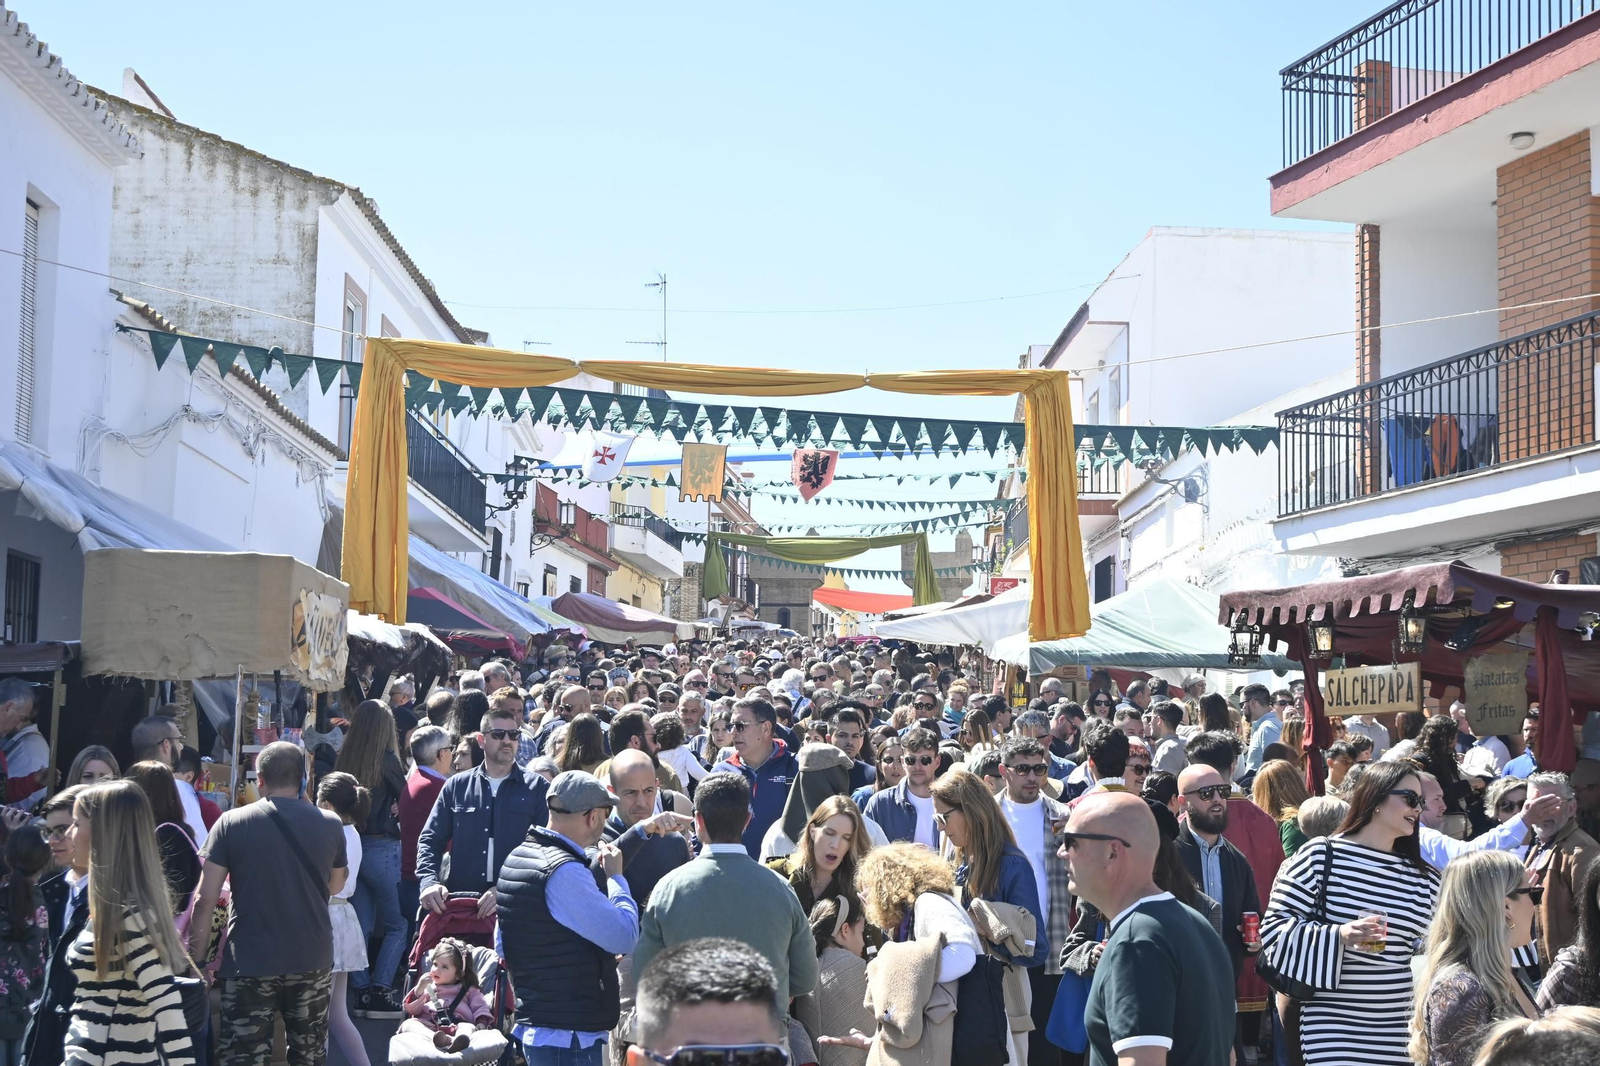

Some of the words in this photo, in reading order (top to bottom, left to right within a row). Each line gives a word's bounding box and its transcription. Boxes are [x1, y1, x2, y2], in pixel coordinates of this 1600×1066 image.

[1327, 671, 1414, 707] SALCHIPAPA
[1473, 670, 1520, 690] Patatas
[1476, 702, 1516, 722] Fritas
